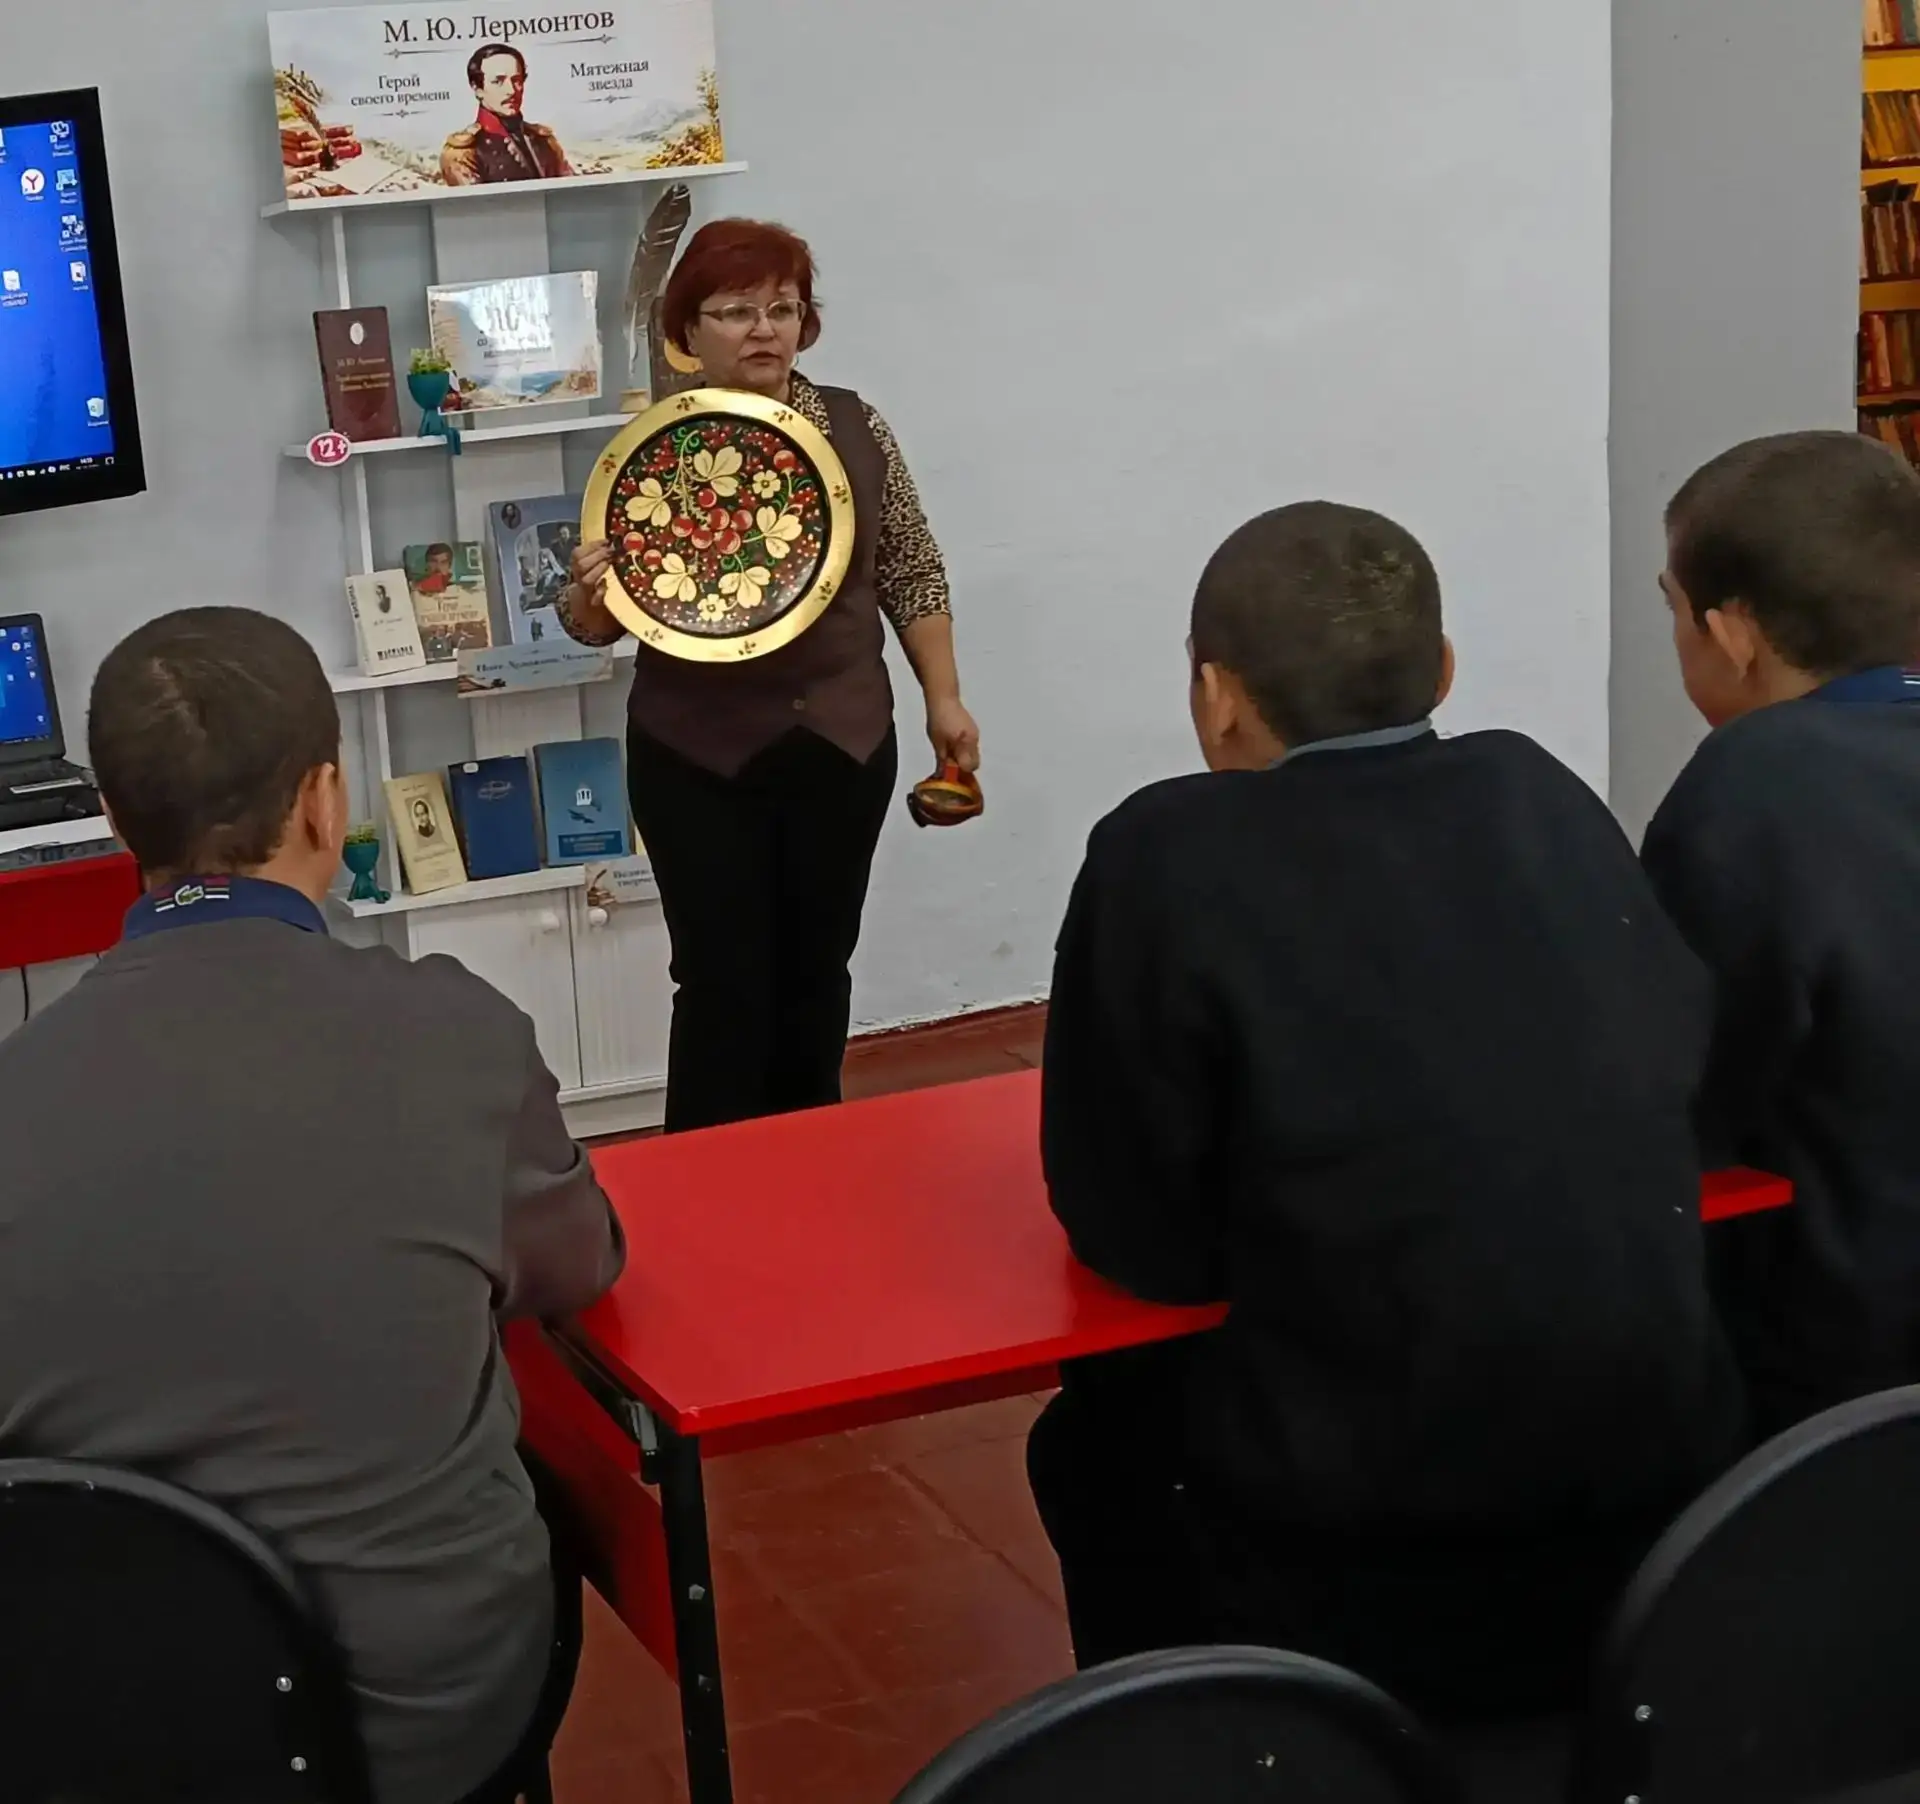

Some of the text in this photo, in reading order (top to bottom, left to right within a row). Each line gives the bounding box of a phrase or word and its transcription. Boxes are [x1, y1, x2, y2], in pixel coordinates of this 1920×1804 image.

[383, 10, 615, 43] М. Ю. Лермонтов
[570, 60, 649, 78] Мятежная
[378, 73, 421, 92] Герой
[588, 78, 633, 92] звезда
[350, 91, 450, 106] своего времени
[317, 437, 347, 458] 12+
